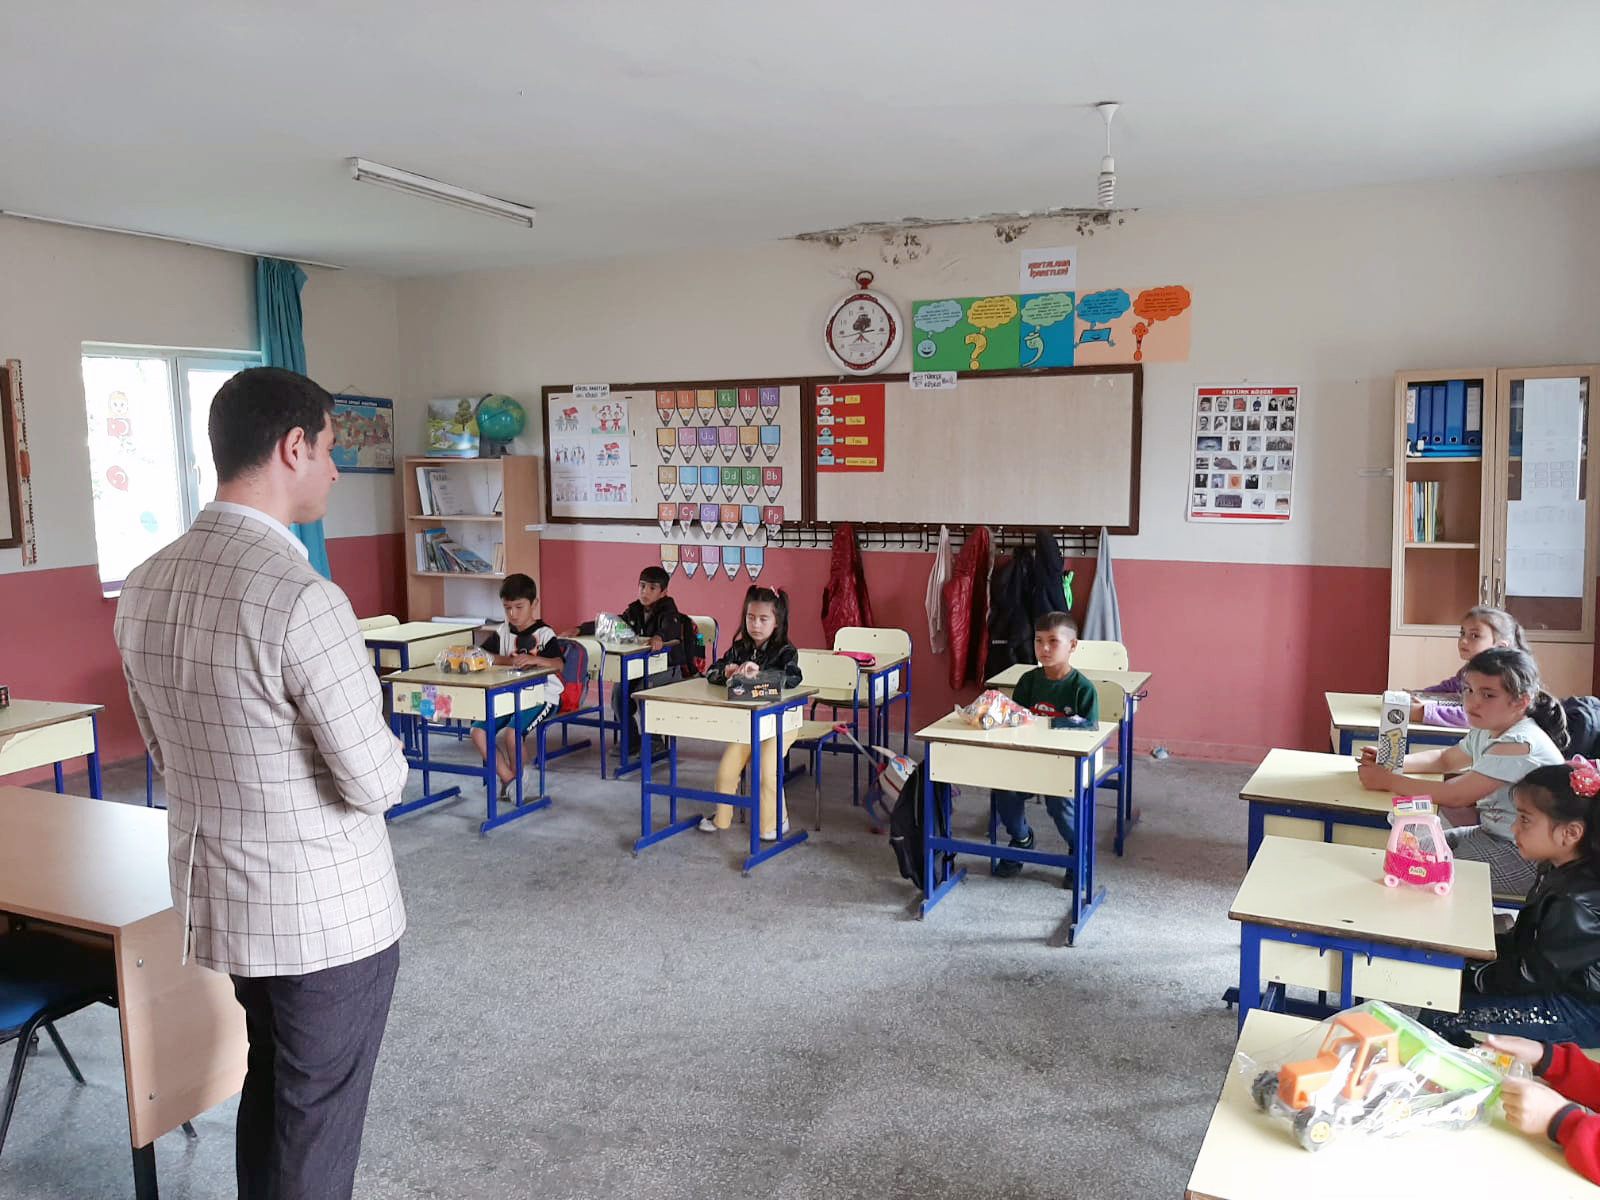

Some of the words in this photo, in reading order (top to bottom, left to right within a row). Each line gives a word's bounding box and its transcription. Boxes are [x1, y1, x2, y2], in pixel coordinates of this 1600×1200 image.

[762, 391, 776, 401] Nn
[723, 470, 737, 480] Dd
[766, 470, 778, 480] Bb
[768, 509, 779, 523] Pp
